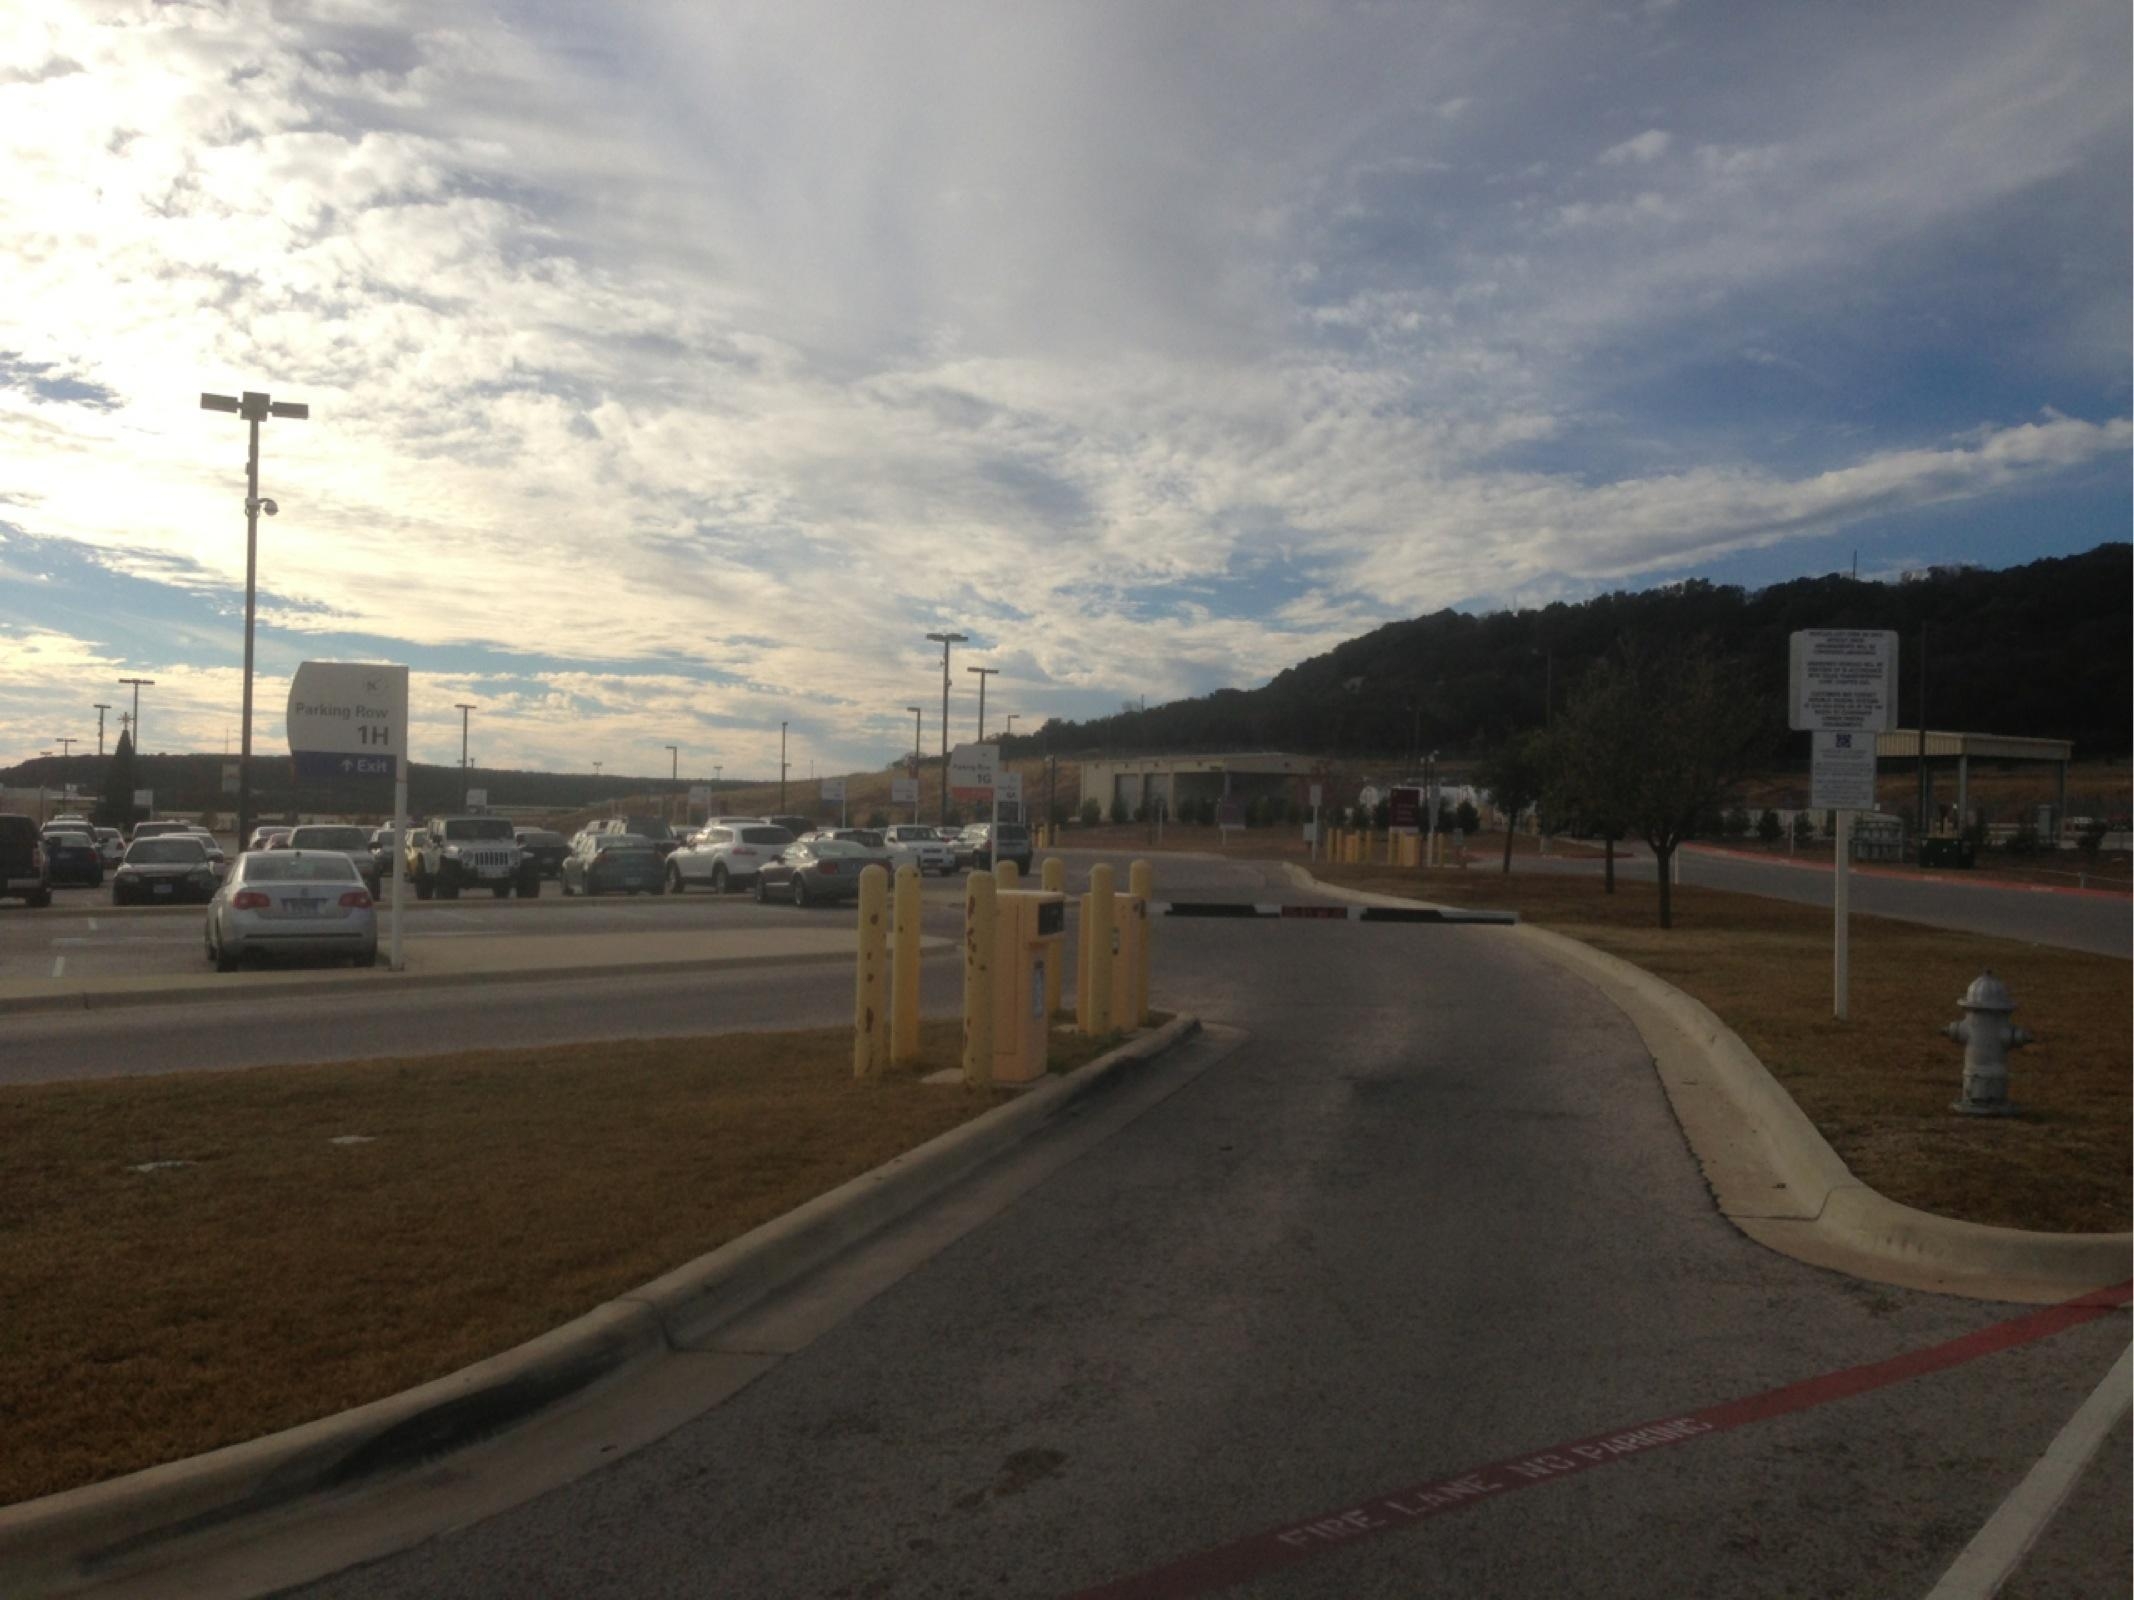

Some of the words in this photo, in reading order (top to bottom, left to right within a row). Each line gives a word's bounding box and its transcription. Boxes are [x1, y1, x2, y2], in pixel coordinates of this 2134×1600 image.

[296, 702, 351, 720] Parking
[355, 704, 389, 719] Row
[357, 725, 389, 746] 1H
[356, 759, 388, 773] Exit
[1277, 1509, 1387, 1547] FIRE
[1387, 1473, 1503, 1516] LANE
[1506, 1453, 1576, 1479] NO
[1571, 1416, 1712, 1461] PARKING
